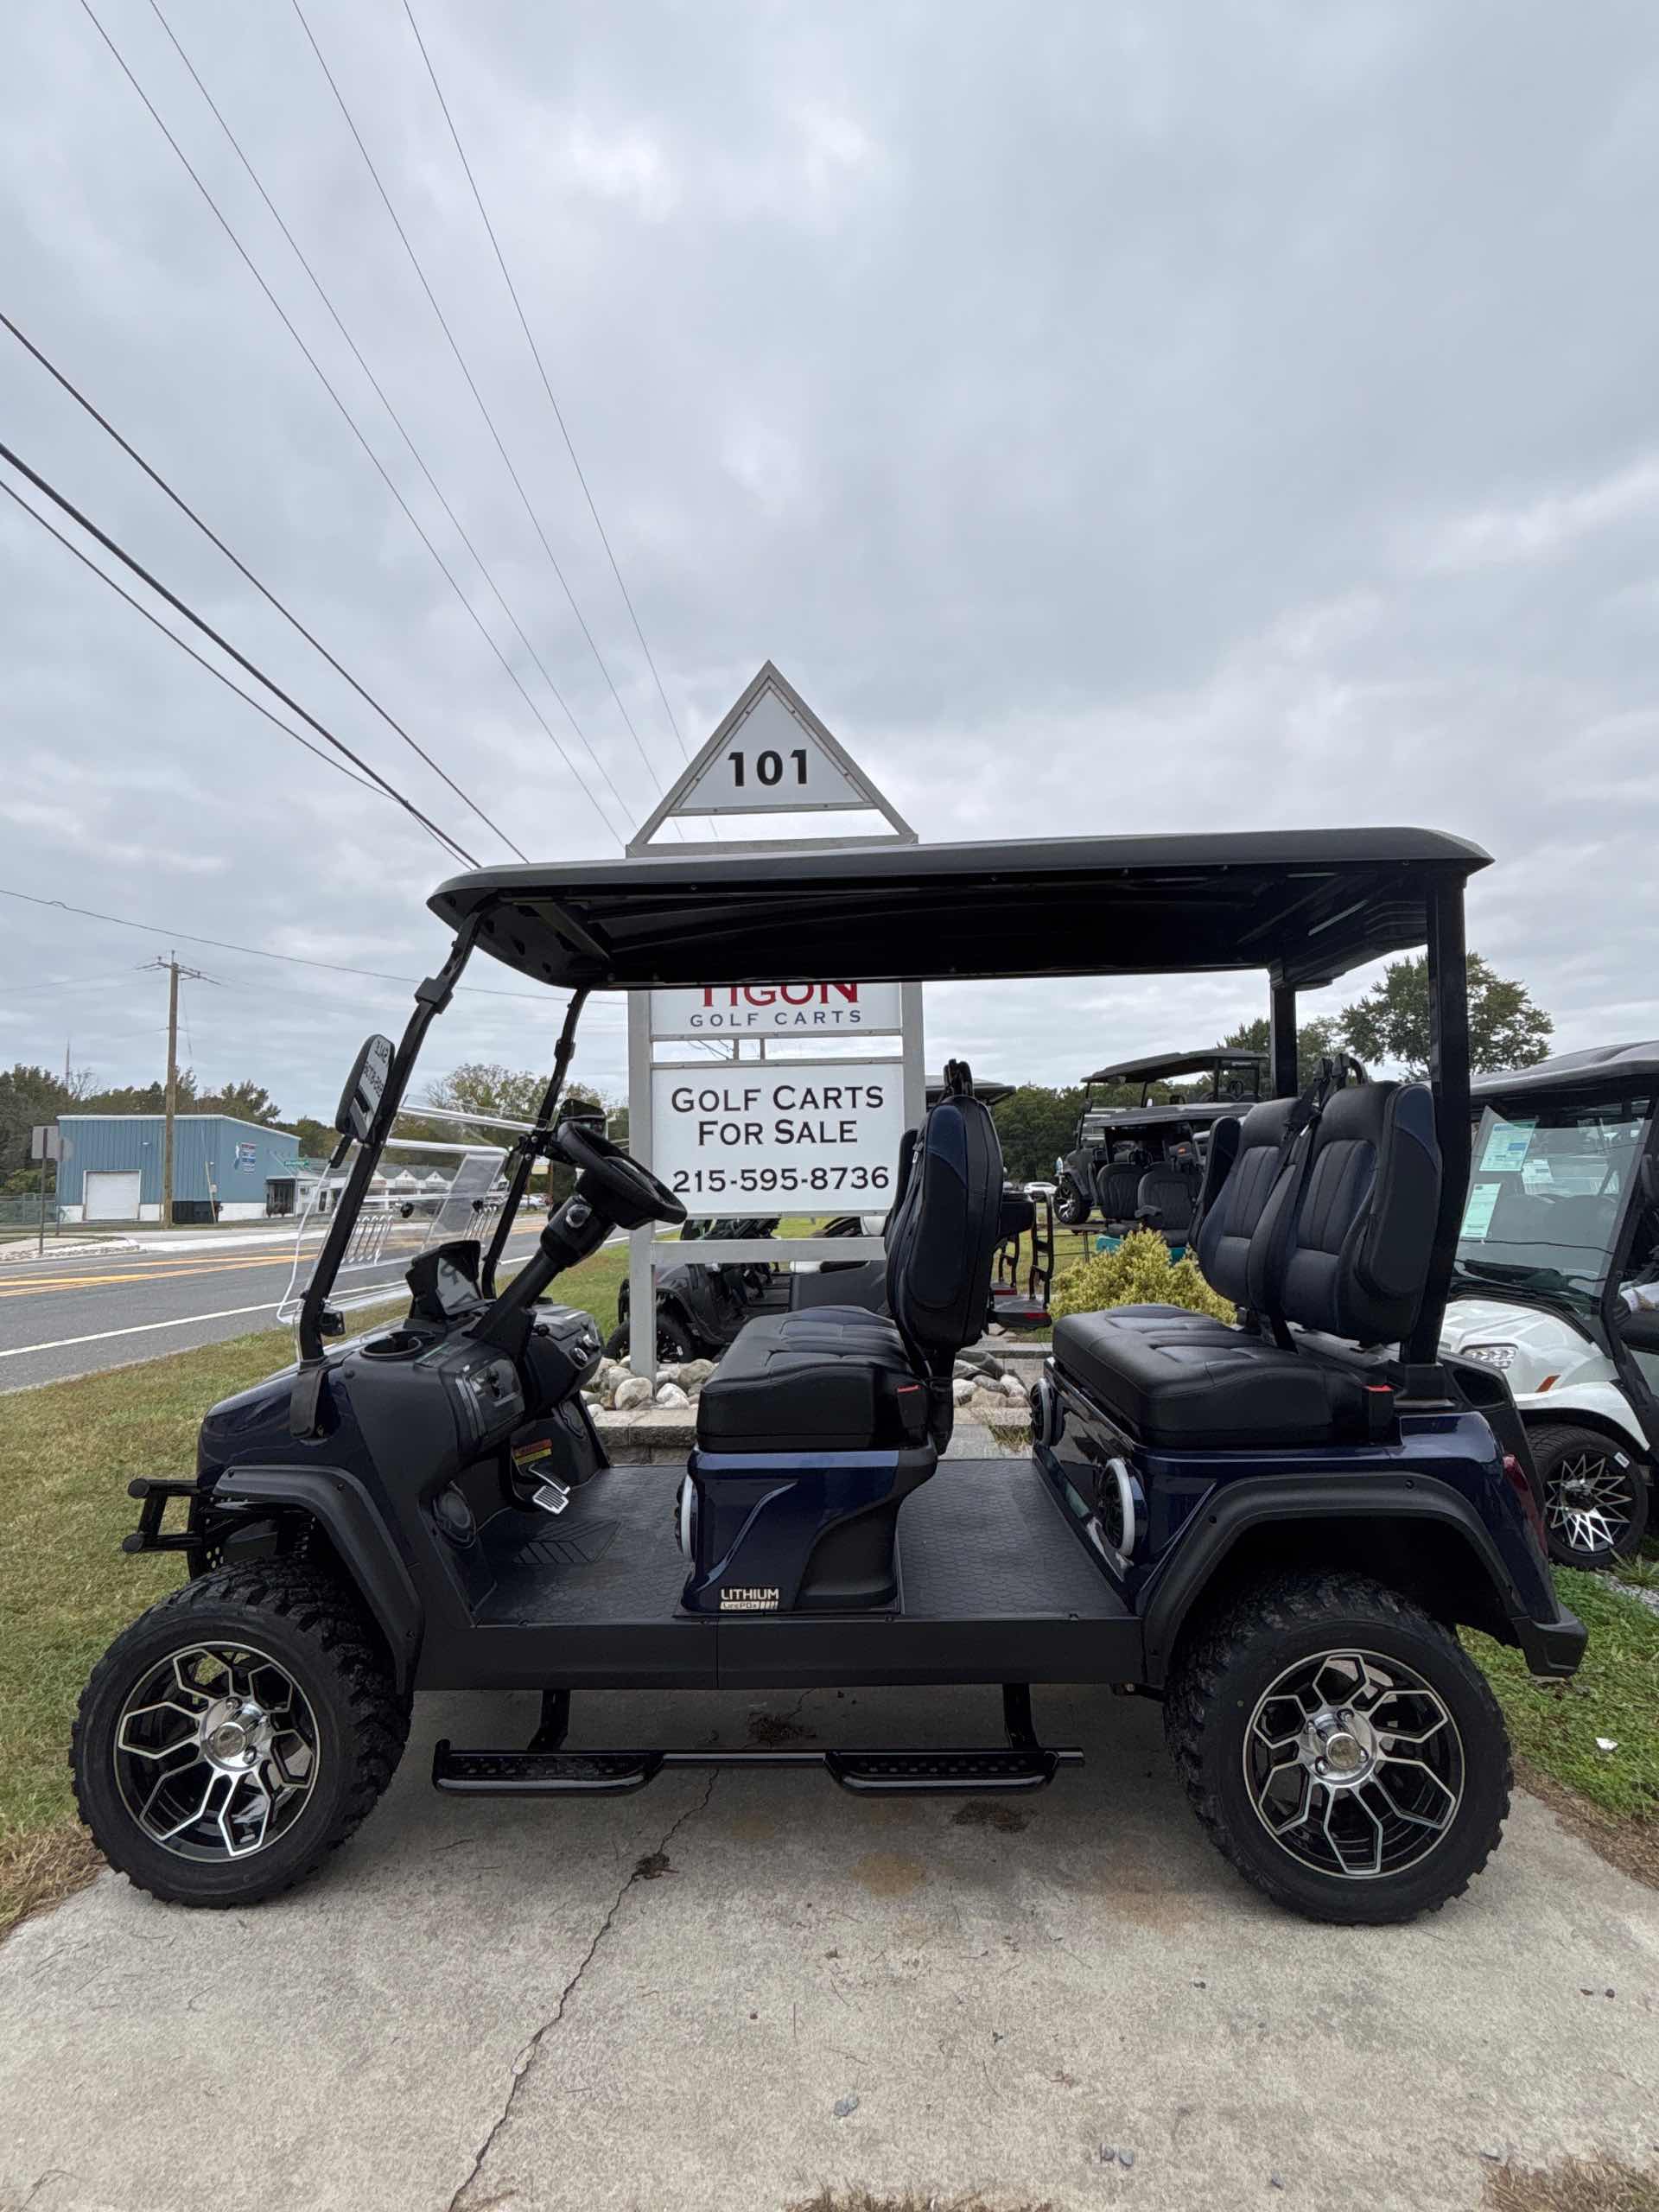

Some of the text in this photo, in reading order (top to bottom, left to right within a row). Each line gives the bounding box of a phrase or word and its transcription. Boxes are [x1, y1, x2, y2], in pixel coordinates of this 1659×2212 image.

[728, 749, 807, 786] 101
[690, 1009, 861, 1027] GOLF CARTS
[671, 1084, 884, 1113] GOLF CARTS
[698, 1119, 858, 1146] FOR SALE
[672, 1166, 889, 1193] 215-595-8736
[721, 1588, 779, 1600] LITHIUM
